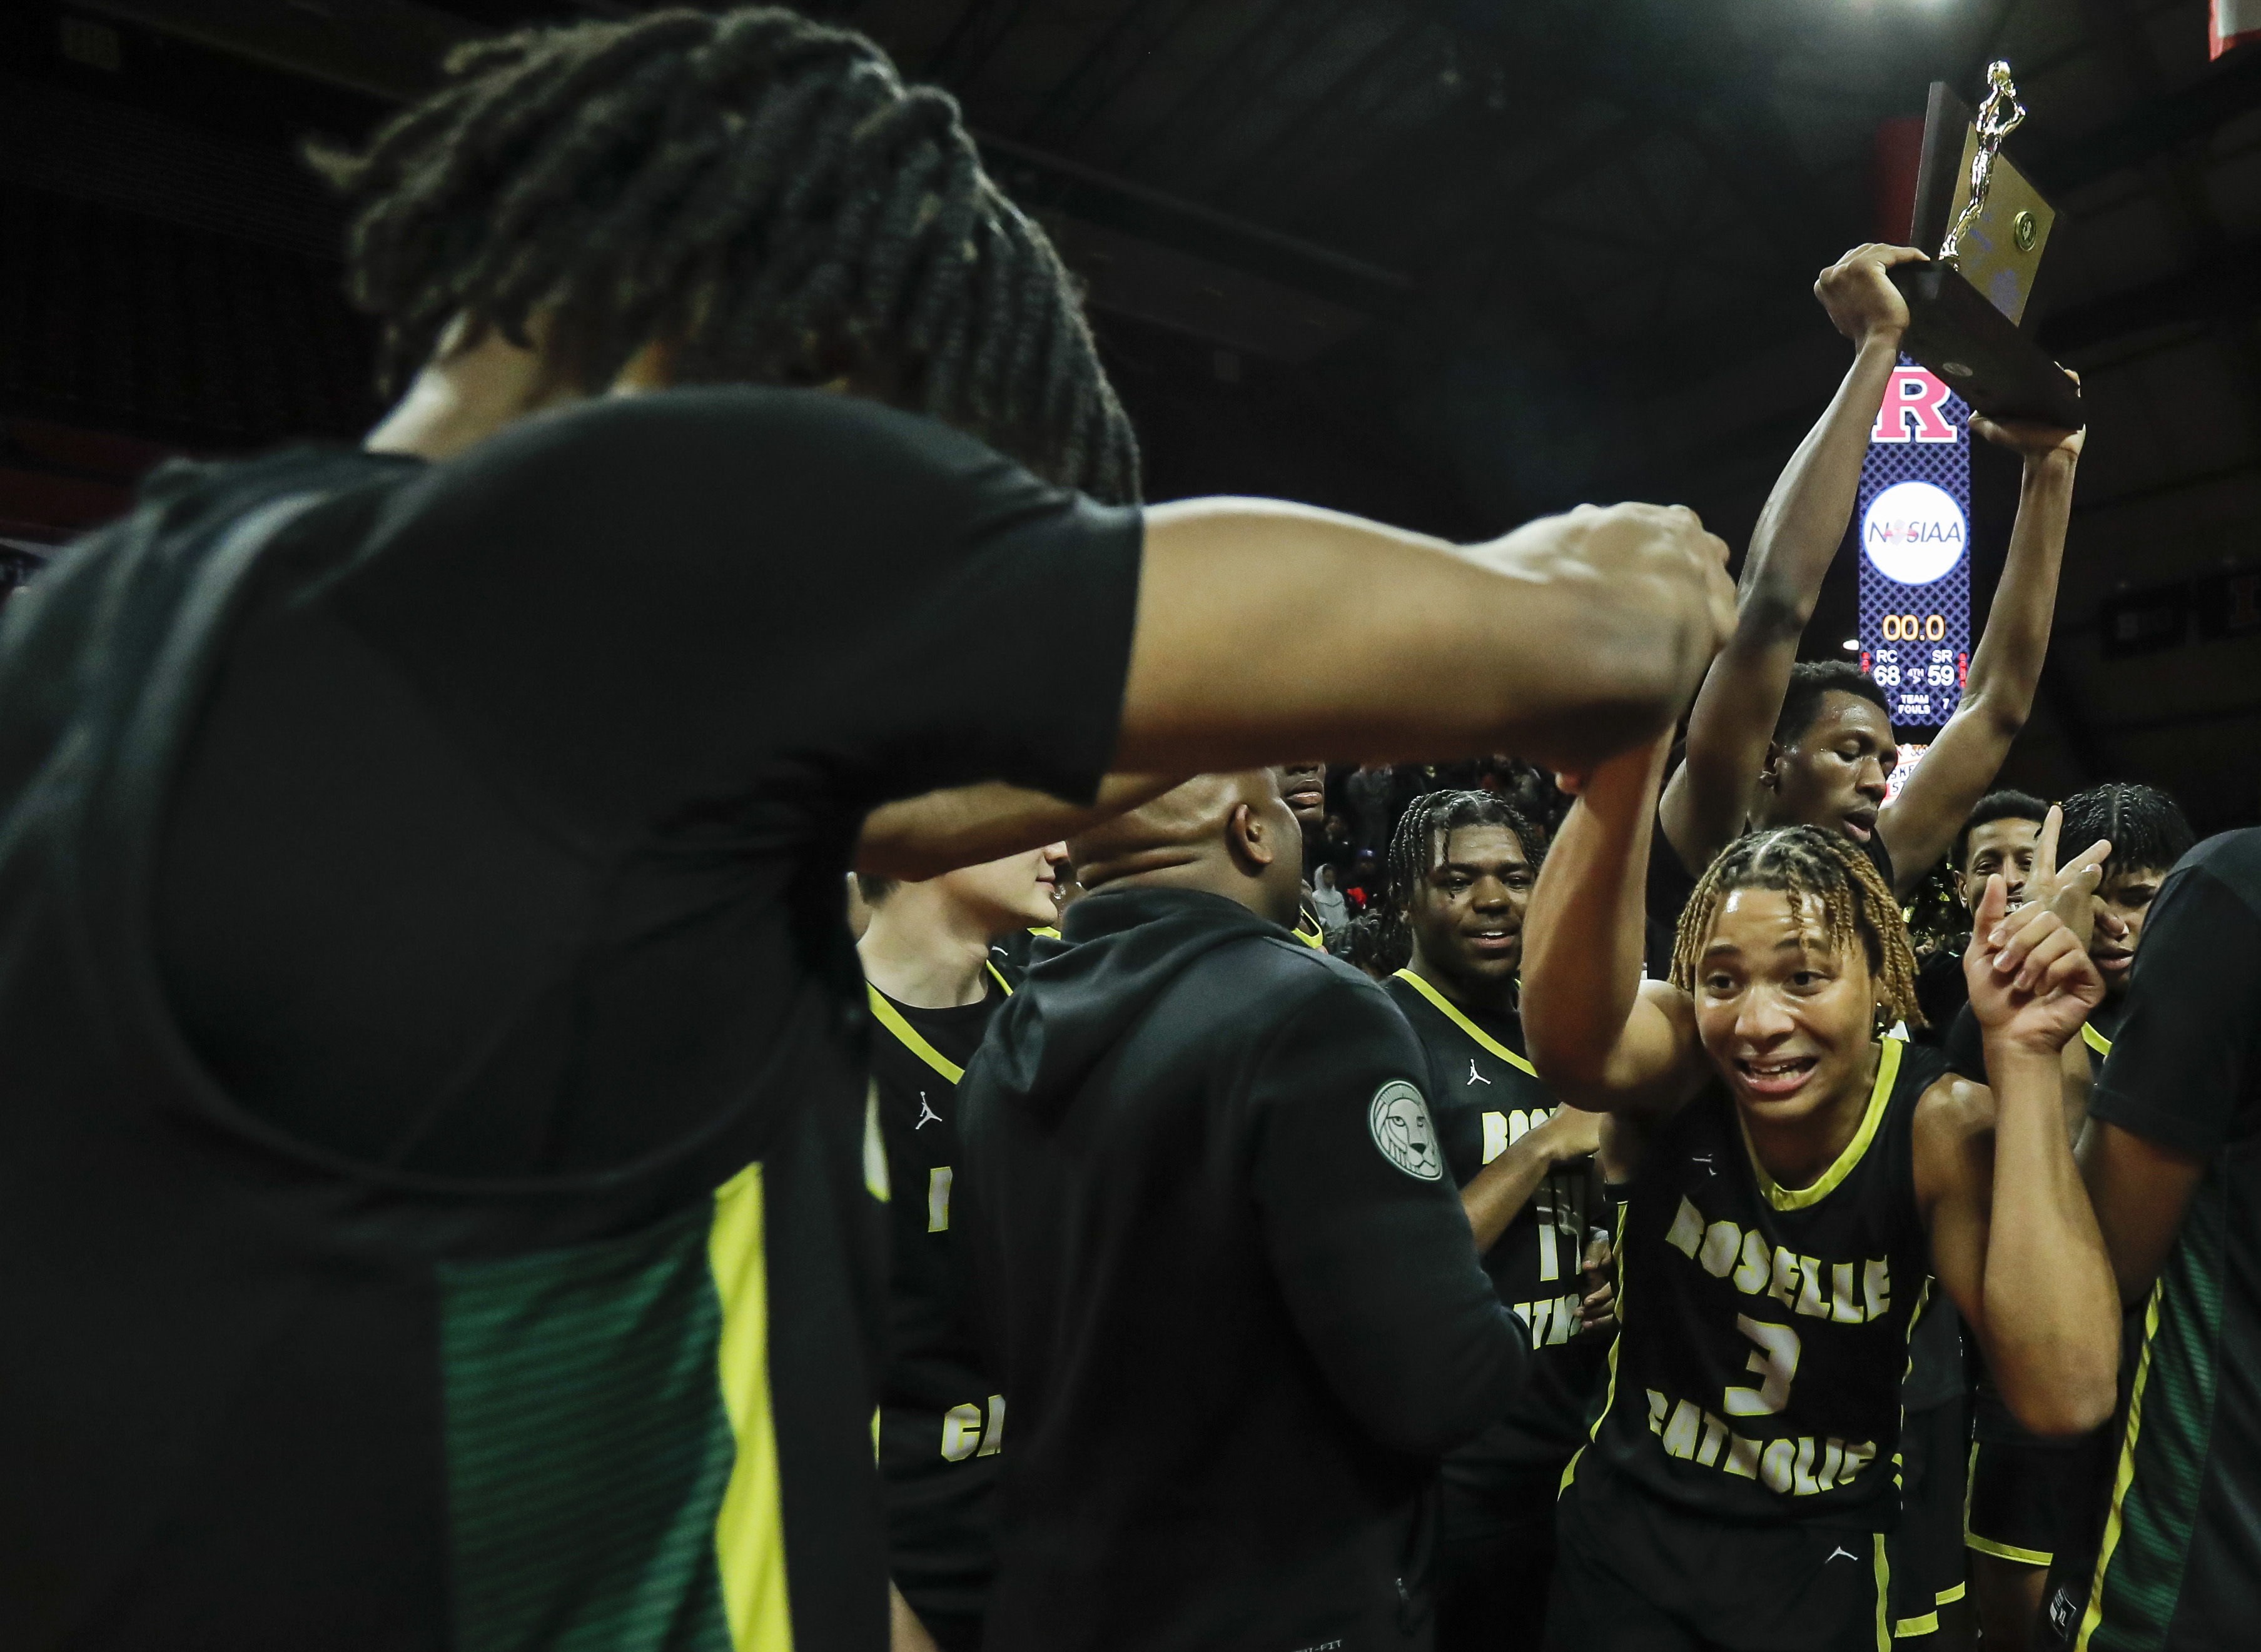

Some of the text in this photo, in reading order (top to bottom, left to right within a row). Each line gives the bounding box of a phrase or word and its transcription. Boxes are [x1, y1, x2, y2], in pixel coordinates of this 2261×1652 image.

[1870, 365, 1958, 443] R
[1882, 614, 1945, 642] 00.0
[1876, 649, 1898, 663] RC
[1931, 649, 1953, 663] SR
[1874, 665, 1901, 687] 68
[1927, 665, 1955, 687] 59
[1898, 704, 1931, 715] FOULS
[1900, 694, 1930, 705] TEAM
[1942, 698, 1950, 710] 7
[1665, 1194, 1891, 1324] ROSELLE
[1723, 1312, 1801, 1416] 3
